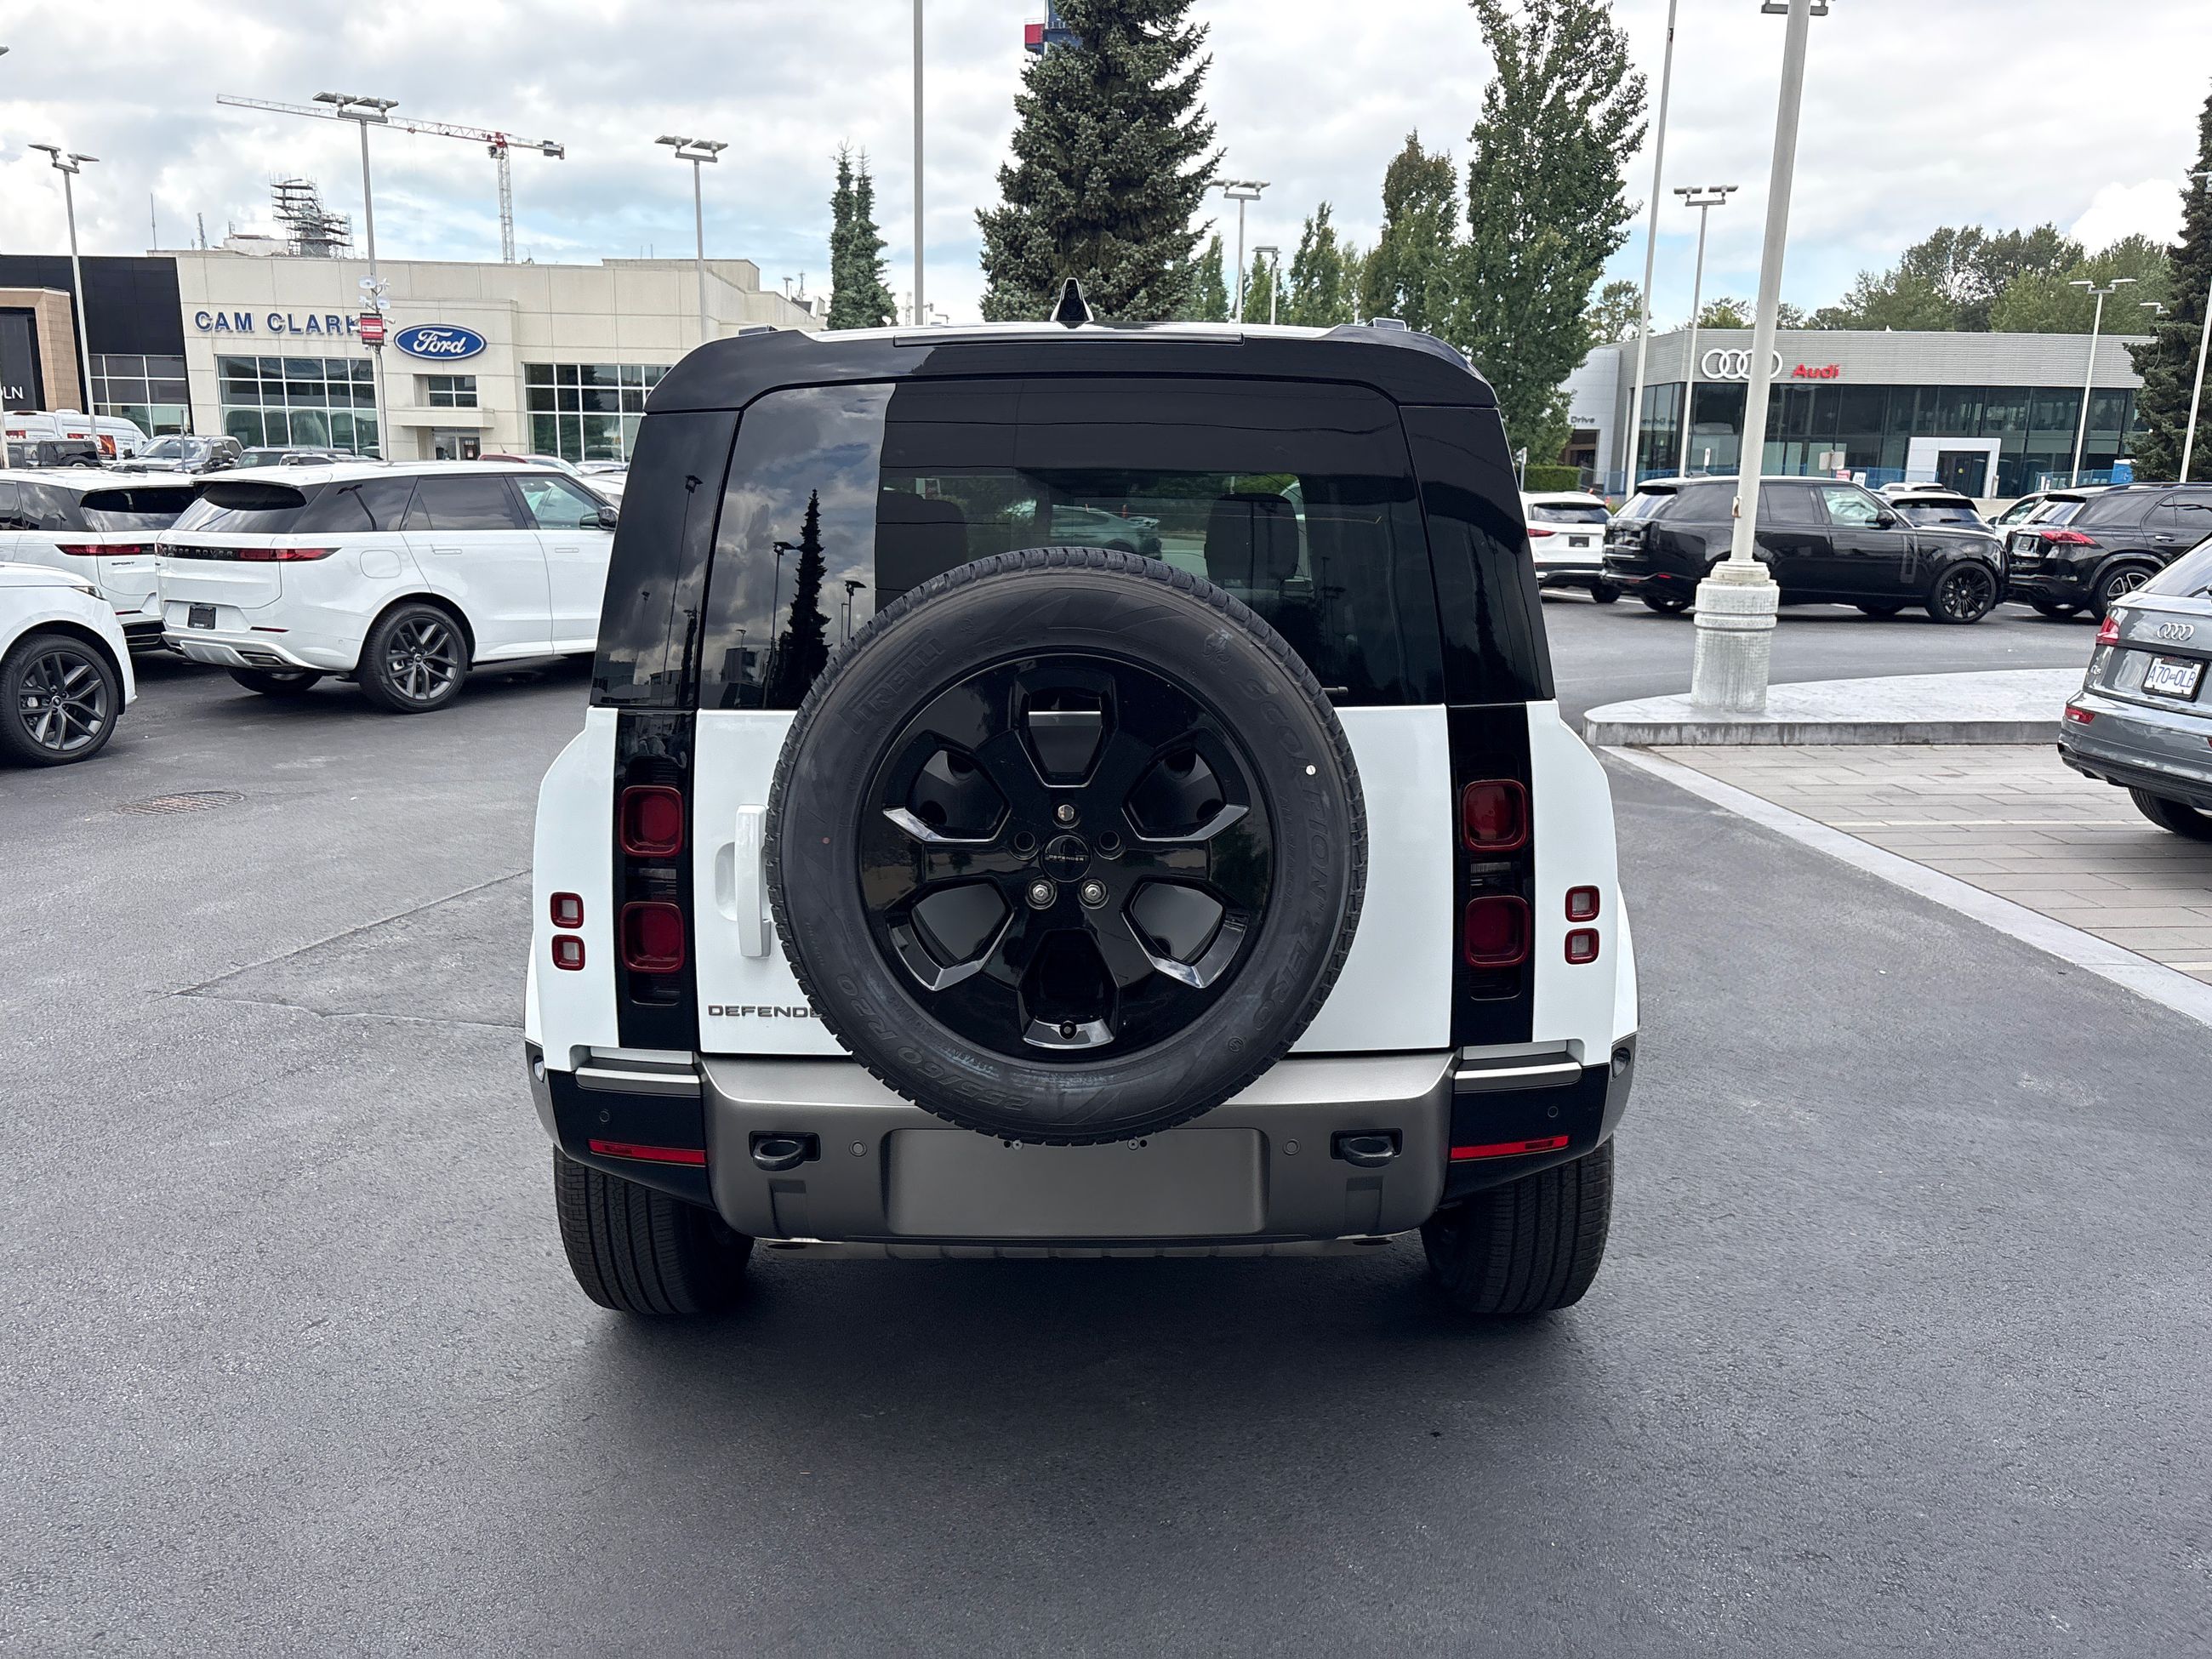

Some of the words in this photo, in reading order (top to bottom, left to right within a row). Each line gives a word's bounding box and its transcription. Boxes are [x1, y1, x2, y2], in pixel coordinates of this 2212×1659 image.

[195, 311, 254, 332] CAM
[413, 331, 466, 354] Ford
[1792, 363, 1840, 379] Audi
[837, 974, 898, 1041] R20
[898, 1046, 1035, 1111] 255/60
